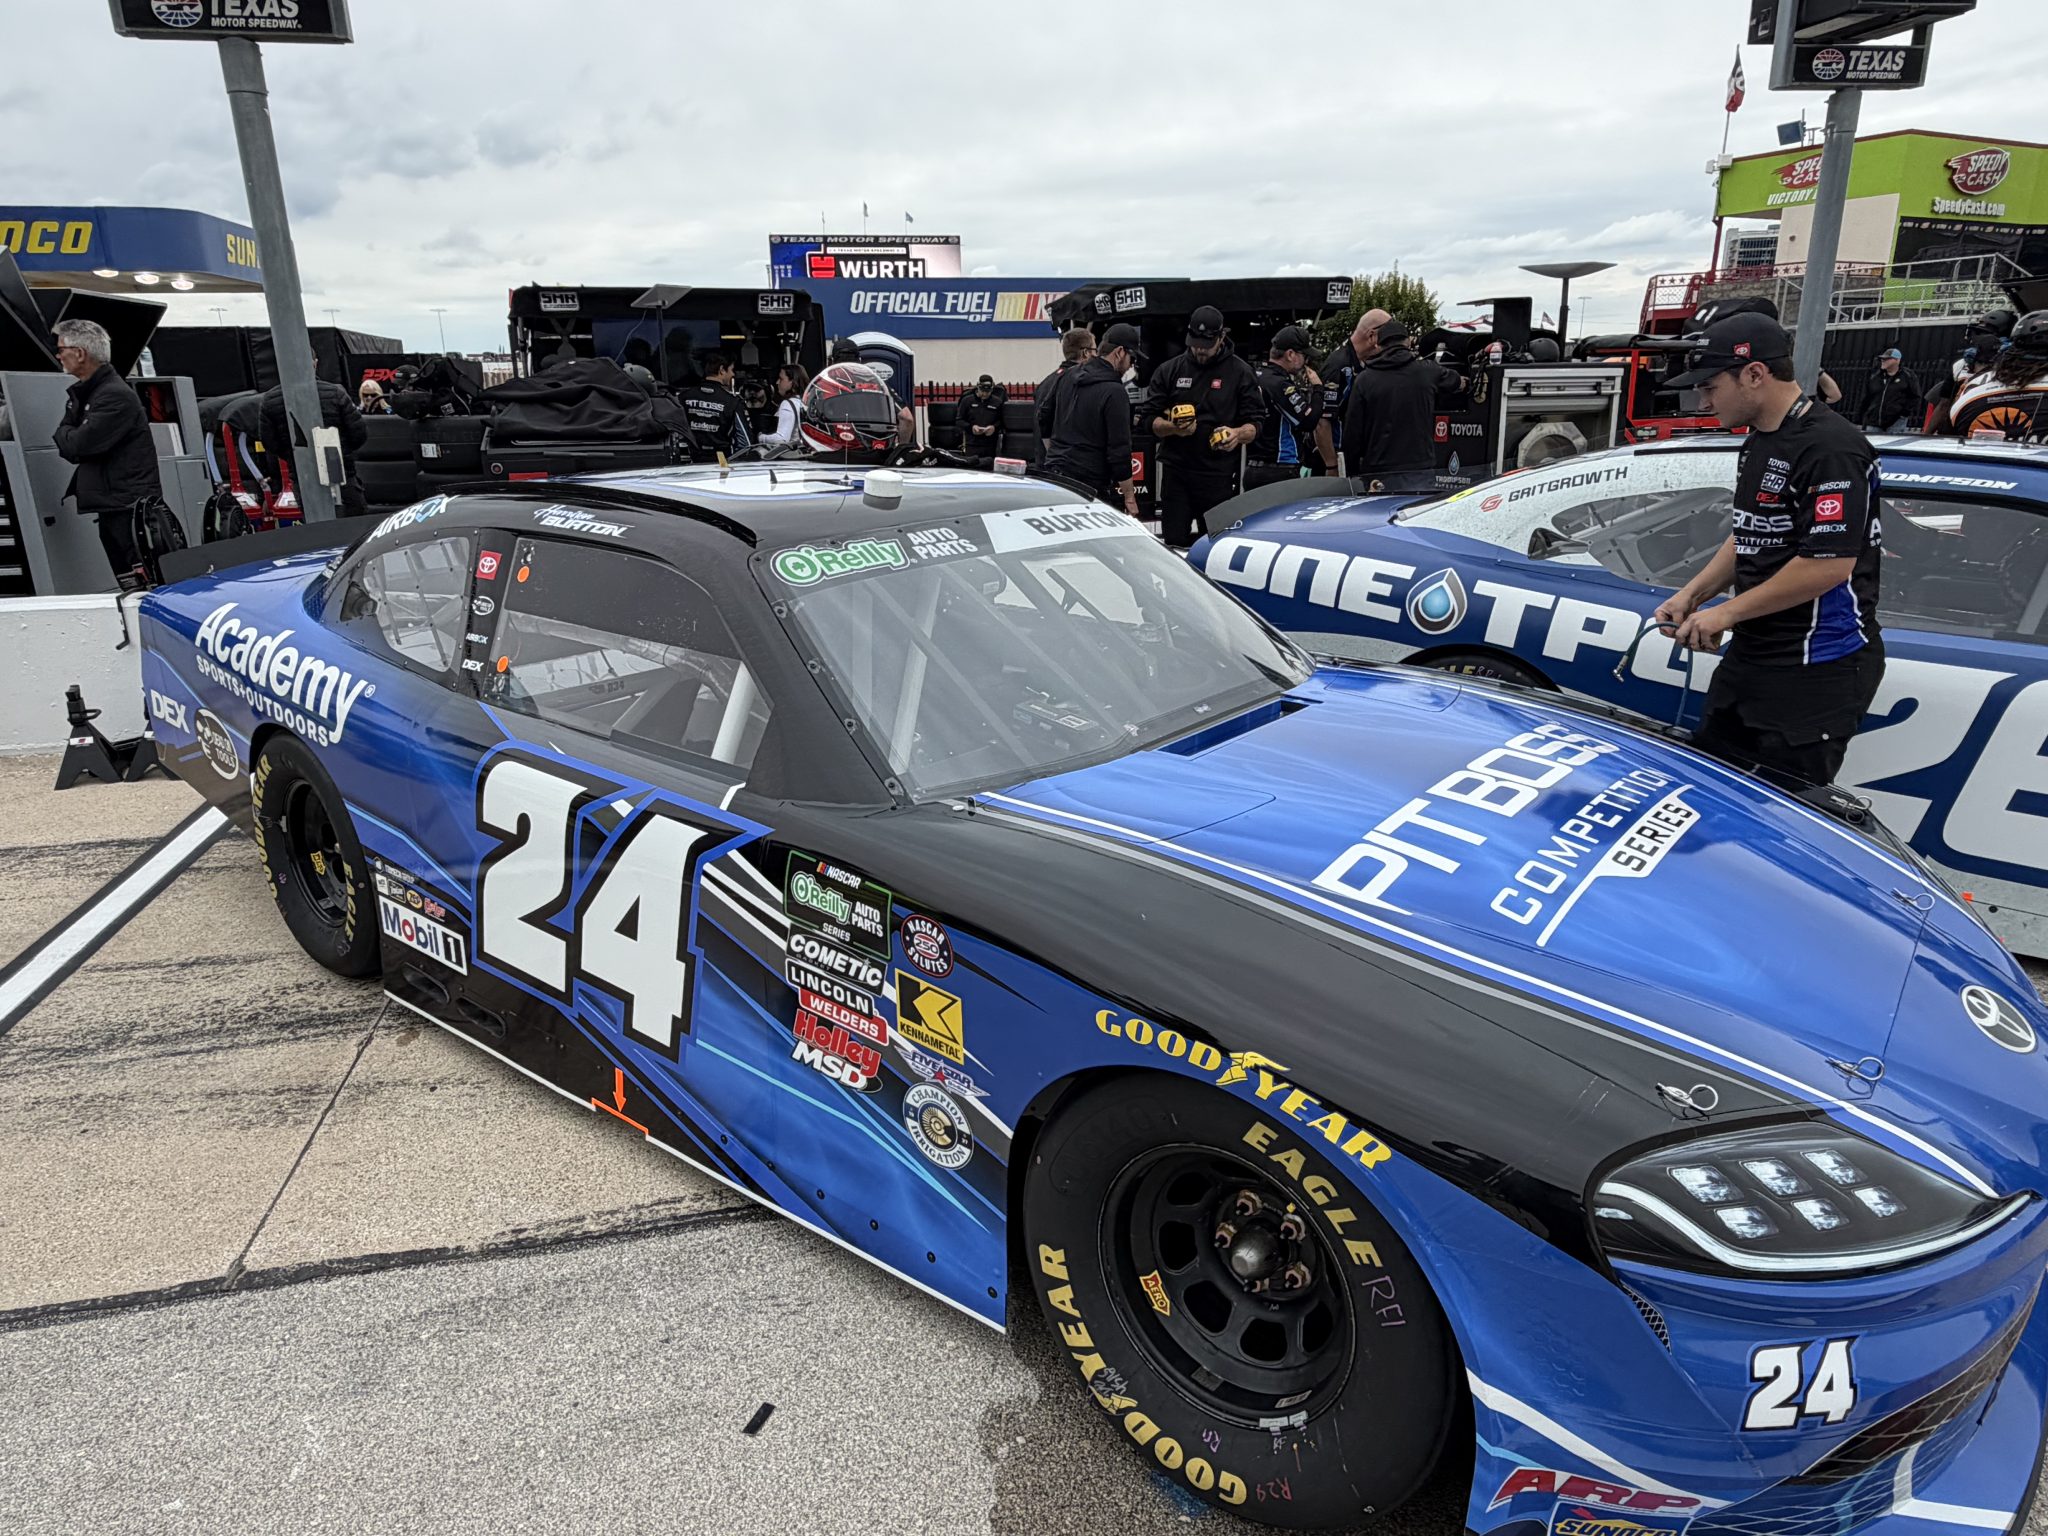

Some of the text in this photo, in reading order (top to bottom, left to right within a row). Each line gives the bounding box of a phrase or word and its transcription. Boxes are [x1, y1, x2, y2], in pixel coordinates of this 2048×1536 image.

[211, 0, 299, 17] TEXAS
[211, 17, 298, 29] MOTOR SPEEDWAY
[1848, 50, 1906, 71] TEXAS
[1846, 71, 1868, 79] MOTOR
[1968, 154, 2008, 172] SPEEDY
[1767, 188, 1813, 206] VICTORY
[1933, 196, 2005, 217] SpeedyCash.com
[226, 234, 261, 268] SUN
[760, 295, 792, 308] SHR
[850, 290, 993, 313] OFFICIAL FUEL
[1116, 290, 1144, 305] SHR
[968, 313, 993, 322] OF
[1450, 423, 1483, 436] TOYOTA
[1508, 466, 1628, 503] GRITGROWTH
[1818, 480, 1851, 492] NASCAR
[366, 494, 460, 543] AIRBOX
[539, 515, 628, 538] BURTON
[1023, 510, 1129, 536] BURTON
[1733, 508, 1793, 532] BOSS
[907, 526, 958, 546] AUTO
[912, 538, 979, 560] PARTS
[778, 541, 905, 585] O'Reilly
[1205, 536, 1416, 623] ONE
[195, 602, 369, 744] Academy
[461, 658, 484, 672] DEX
[150, 689, 190, 735] DEX
[1311, 720, 1621, 916] PIT BOSS
[1489, 764, 1679, 926] COMPETITION
[1611, 801, 1693, 873] SERIES
[826, 865, 862, 890] NASCAR
[482, 760, 709, 1048] 24
[793, 875, 850, 922] O'Reilly
[854, 901, 881, 922] AUTO
[383, 901, 440, 957] Mobil
[448, 936, 464, 967] 1
[822, 922, 851, 942] SERIES
[851, 913, 884, 938] PARTS
[907, 919, 946, 946] NASCAR
[907, 946, 948, 973] SALUTES
[914, 938, 938, 953] 250
[789, 934, 883, 987] COMETIC
[790, 965, 869, 1015] LINCOLN
[809, 995, 879, 1038] WELDERS
[792, 1009, 882, 1079] Holley
[899, 1020, 962, 1060] KENNAMETAL
[791, 1040, 868, 1090] MSD
[911, 1050, 973, 1090] FIVE STAR
[911, 1088, 965, 1126] CHAMPION
[910, 1125, 967, 1165] IRRIGATION
[1242, 1120, 1384, 1269] EAGLE
[1145, 1279, 1166, 1309] AERO
[1744, 1339, 1854, 1430] 24
[1494, 1468, 1701, 1510] ARP
